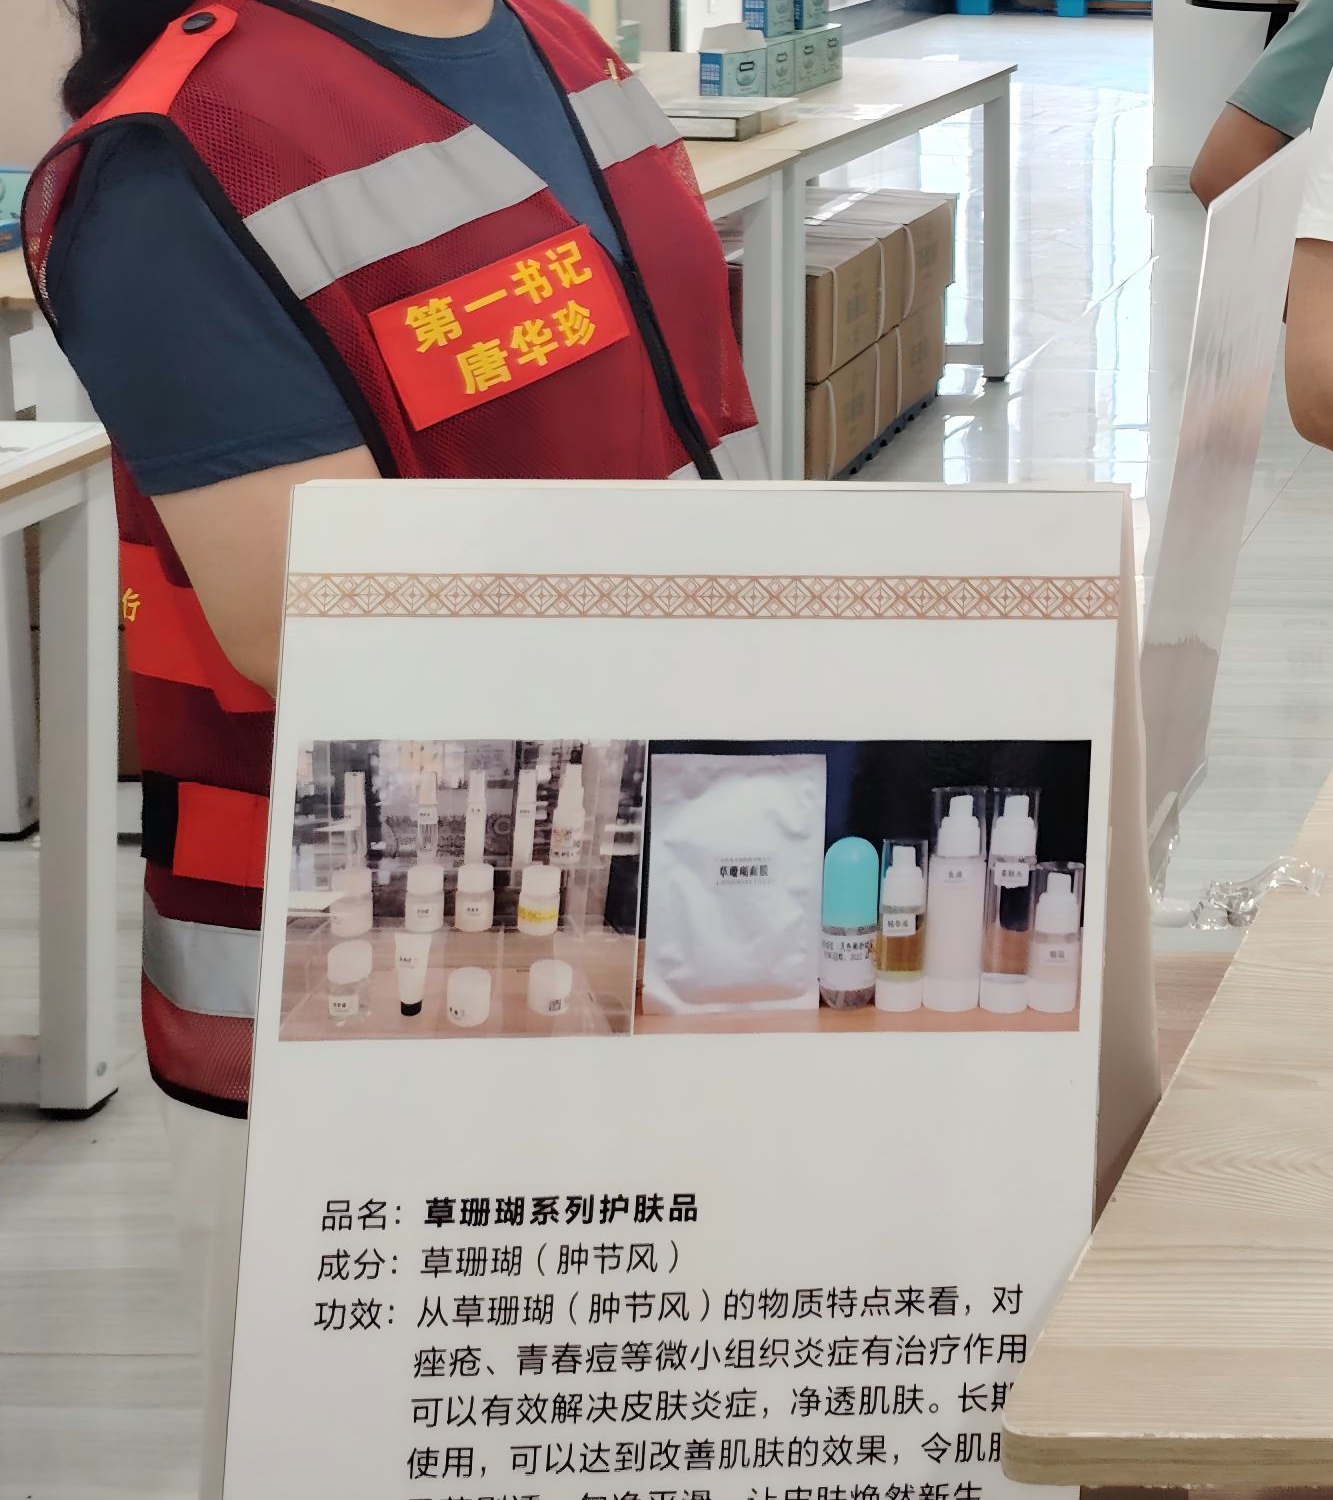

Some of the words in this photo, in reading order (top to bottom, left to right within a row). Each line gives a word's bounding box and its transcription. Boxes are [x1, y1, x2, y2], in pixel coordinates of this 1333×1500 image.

[404, 240, 593, 353] 第一书记
[455, 299, 596, 395] 唐华珍
[321, 1193, 699, 1231] 品名:草珊瑚系列护肤品
[316, 1242, 680, 1281] 成分:草珊瑚(肿节风)
[313, 1284, 1024, 1331] 功效:从草珊瑚(肿节风)的物质特点来看,对
[413, 1333, 1027, 1377] 痤疮、青春痘等微小组织炎症有治疗作用
